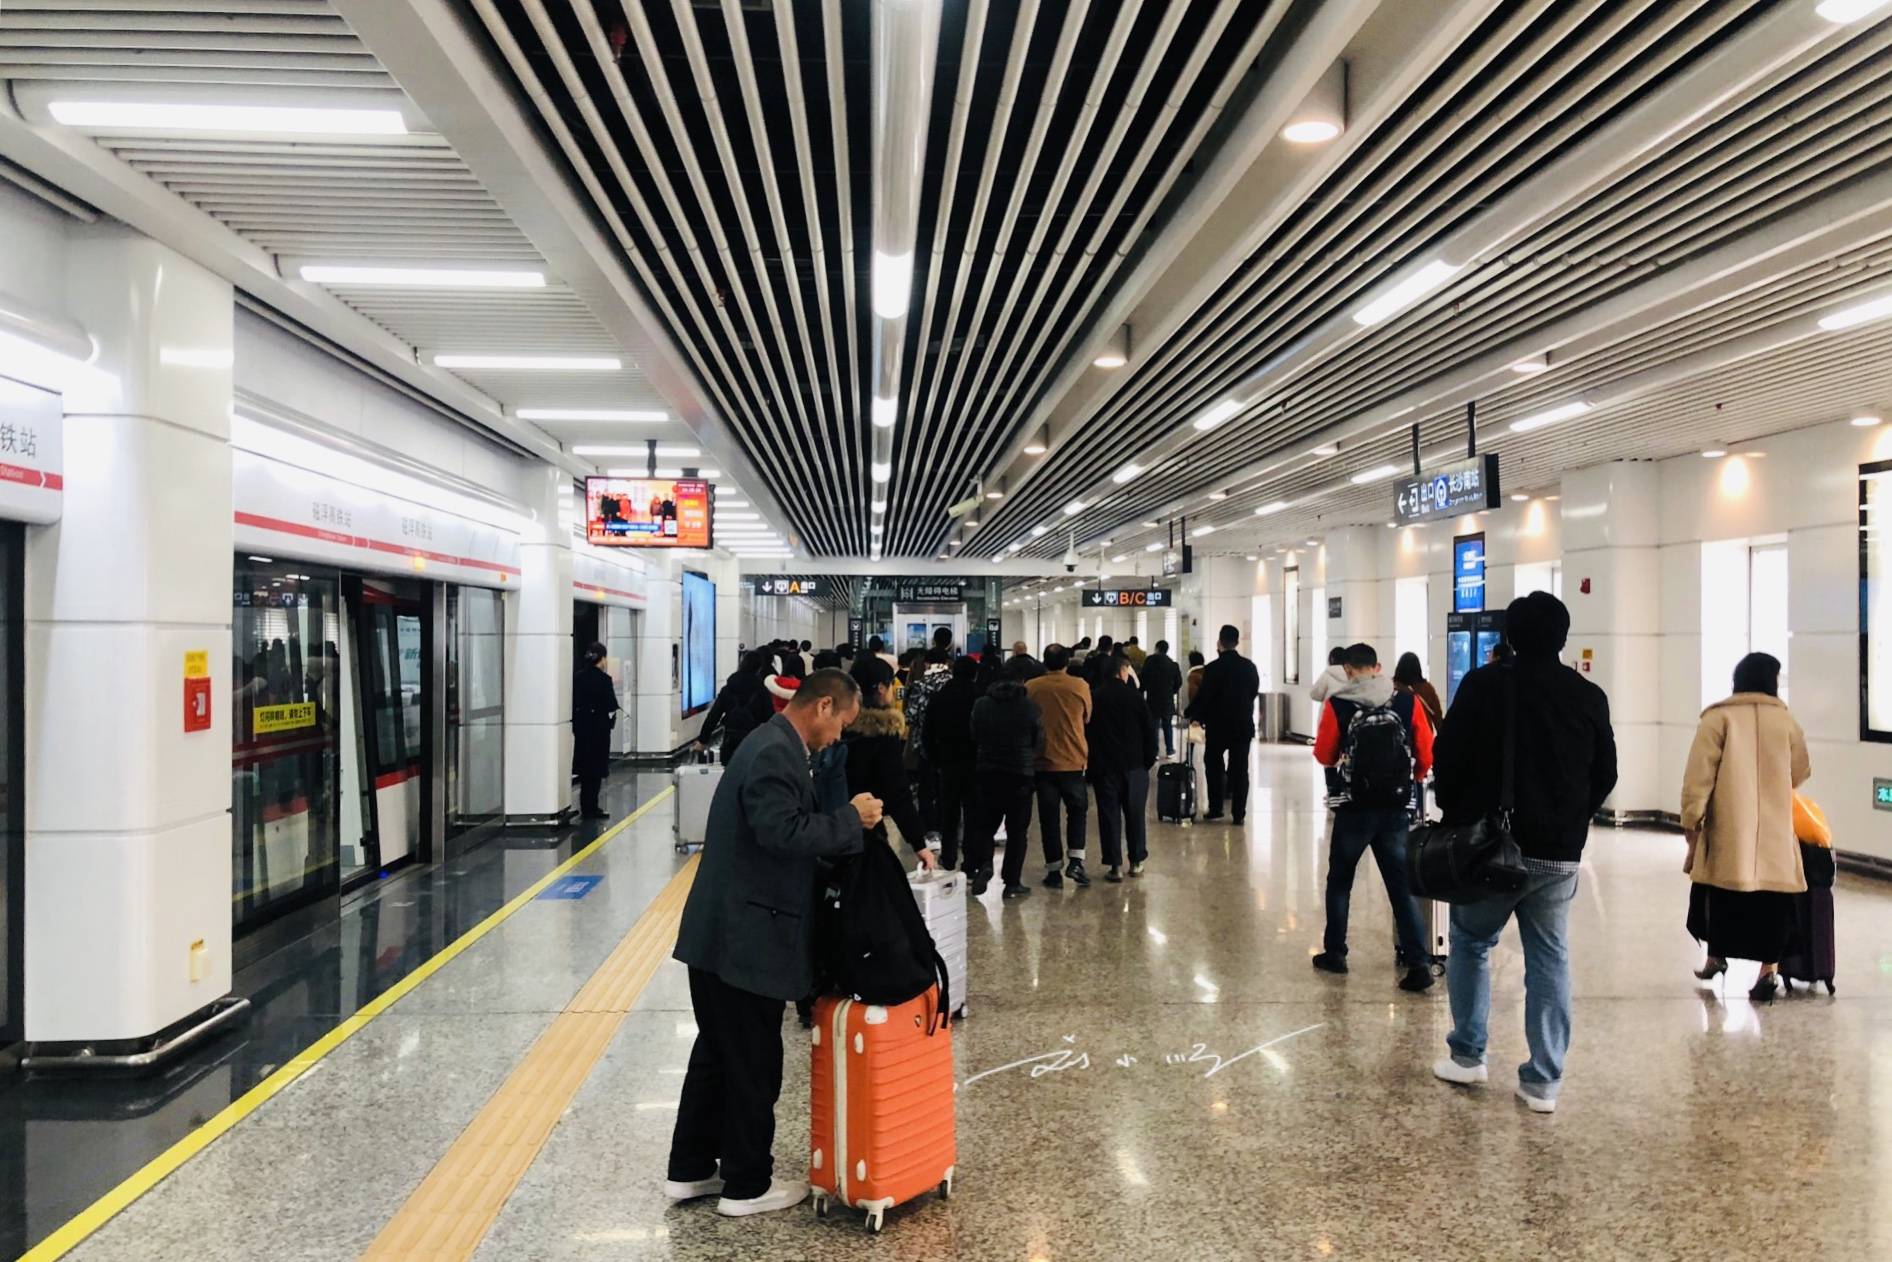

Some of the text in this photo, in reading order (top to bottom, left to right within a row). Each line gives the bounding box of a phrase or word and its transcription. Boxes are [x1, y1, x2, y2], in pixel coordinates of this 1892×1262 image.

[1421, 483, 1434, 502] 出口
[1448, 468, 1480, 493] 长沙南站
[789, 581, 800, 593] A
[917, 586, 959, 596] 无障碍电梯
[1120, 592, 1162, 604] B/C 出口
